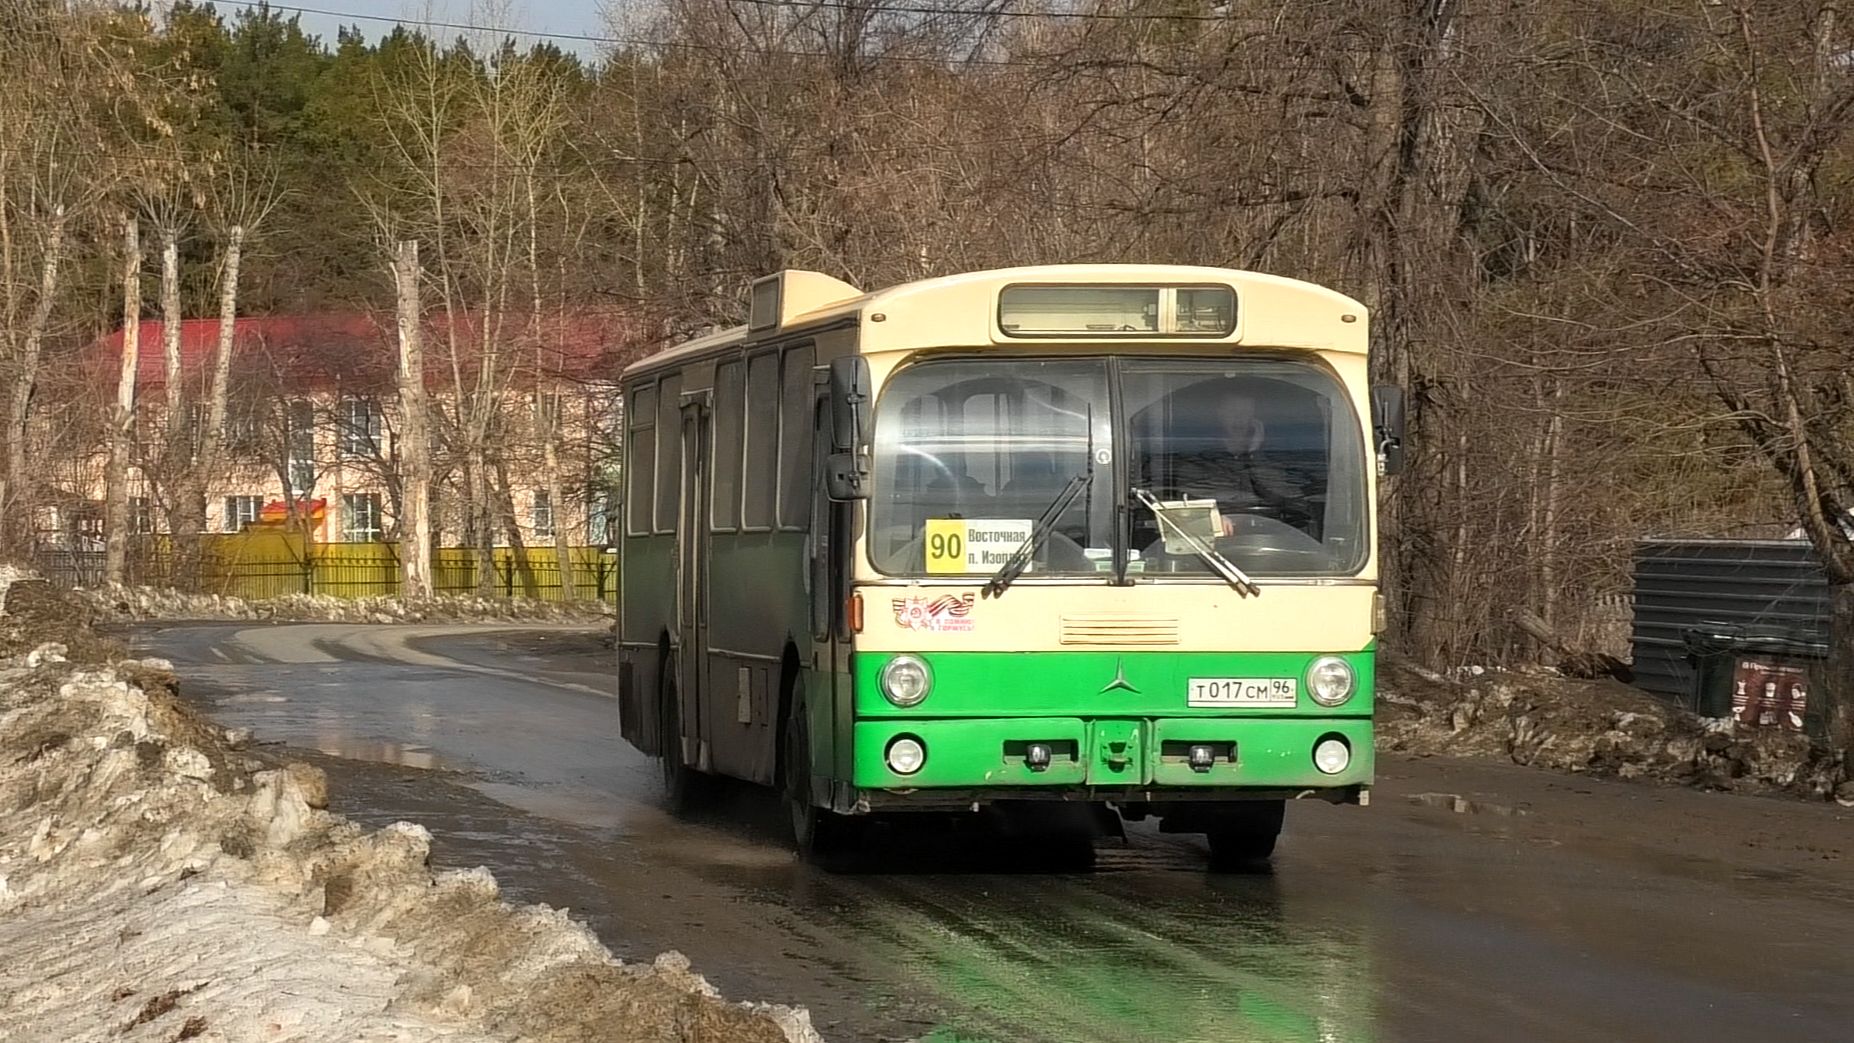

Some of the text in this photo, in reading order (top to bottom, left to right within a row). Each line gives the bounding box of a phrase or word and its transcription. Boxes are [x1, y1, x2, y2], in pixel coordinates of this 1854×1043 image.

[968, 528, 1026, 543] Восточная
[931, 533, 961, 559] 90
[968, 551, 1030, 565] п. Изоп
[1273, 680, 1290, 694] 96
